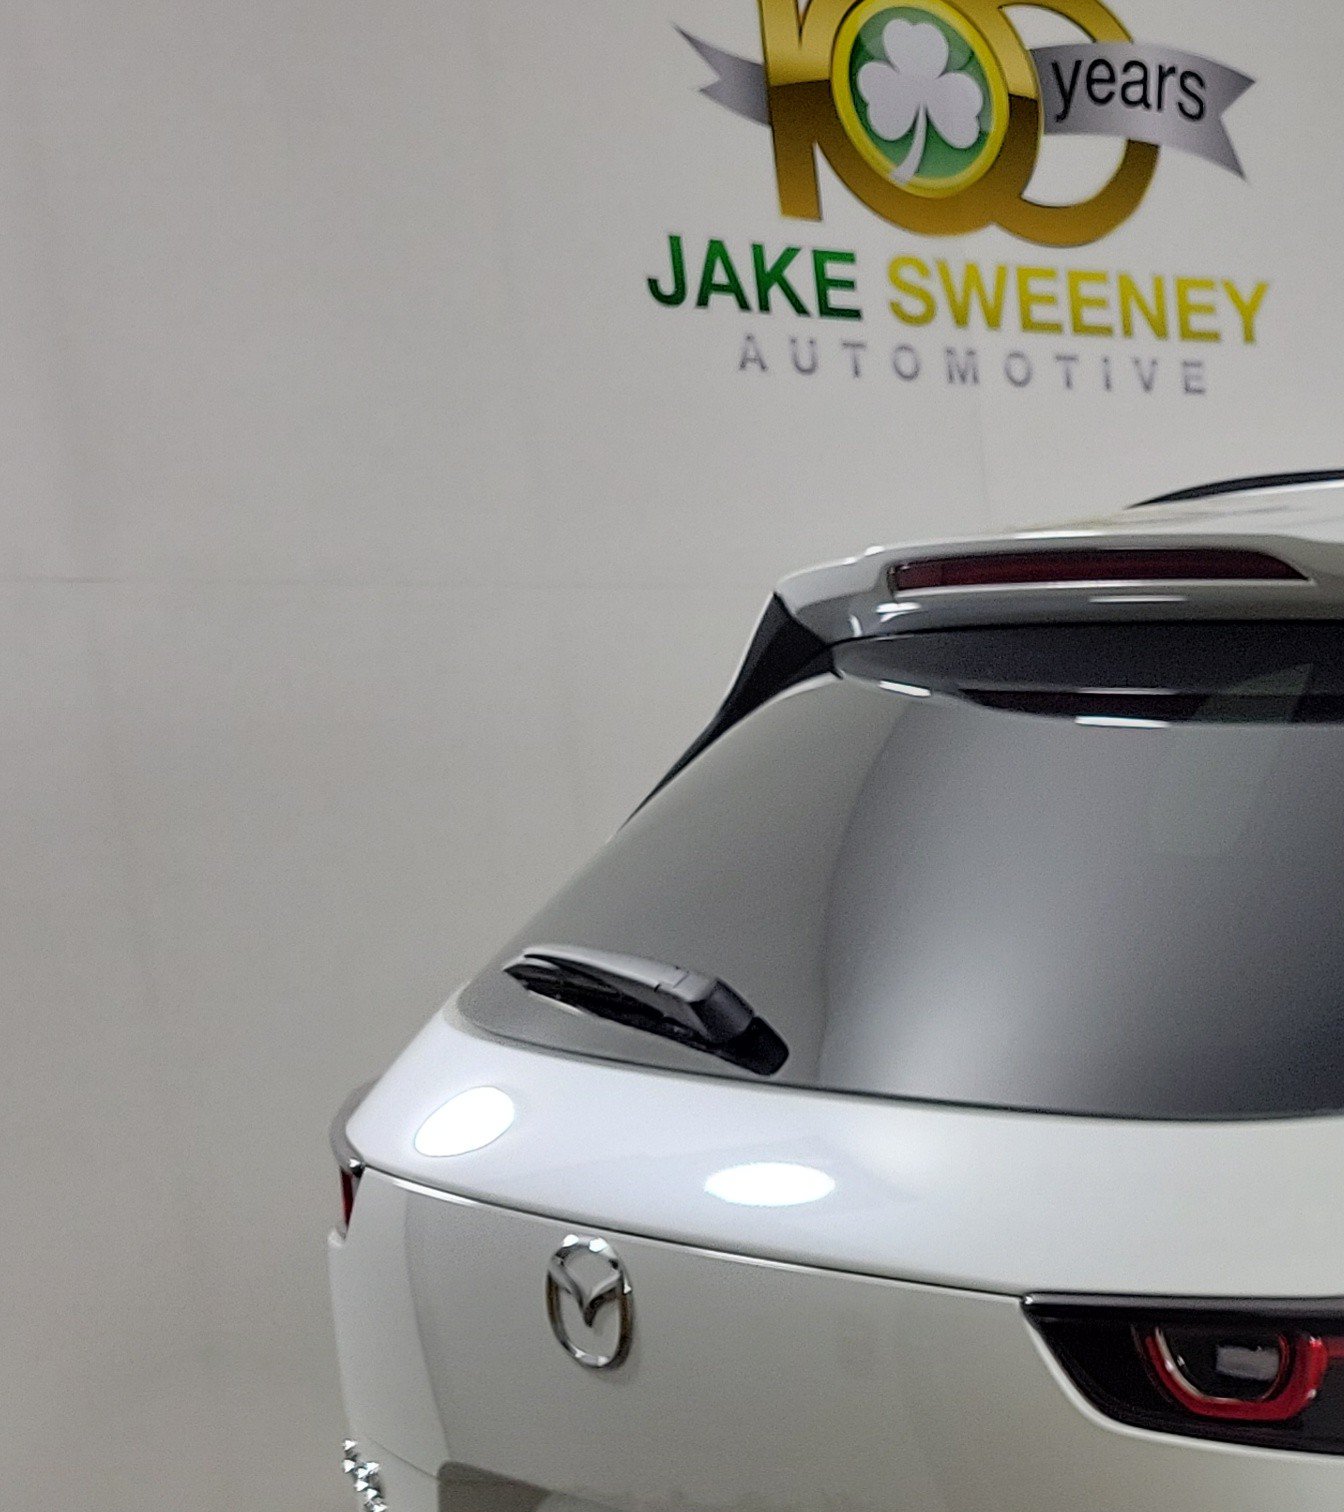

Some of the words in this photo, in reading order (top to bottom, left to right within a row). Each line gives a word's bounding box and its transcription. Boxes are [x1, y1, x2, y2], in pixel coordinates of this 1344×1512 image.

[1050, 57, 1208, 123] years
[646, 234, 864, 322] JAKE
[886, 255, 1271, 346] SWEENEY
[738, 333, 1210, 396] AUTOMOTIVE
